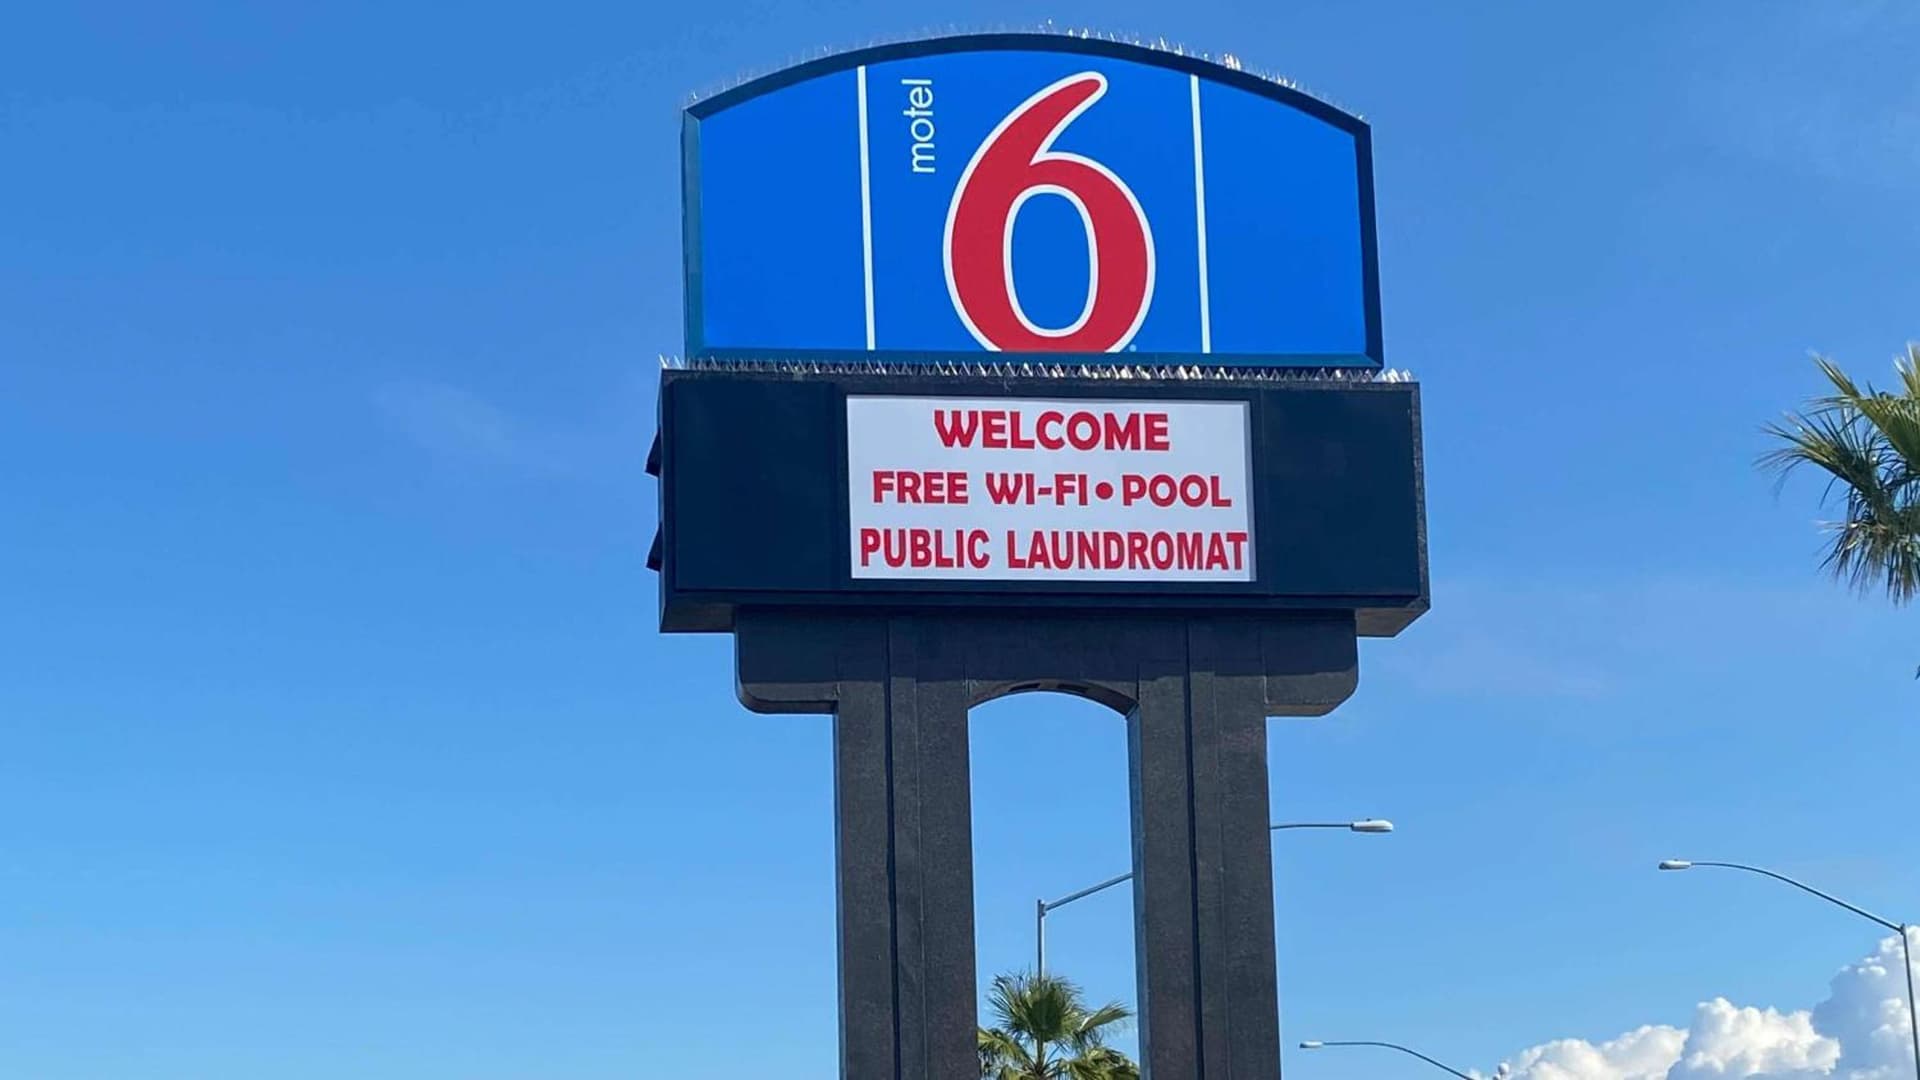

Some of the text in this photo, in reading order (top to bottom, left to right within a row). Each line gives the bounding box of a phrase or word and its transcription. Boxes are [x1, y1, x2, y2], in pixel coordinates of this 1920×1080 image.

[901, 78, 936, 173] motel
[942, 70, 1156, 353] 6
[933, 409, 1170, 451] WELCOME
[872, 470, 969, 504] FREE
[1121, 474, 1232, 508] POOL
[859, 527, 1248, 571] PUBLIC LAUNDROMAT
